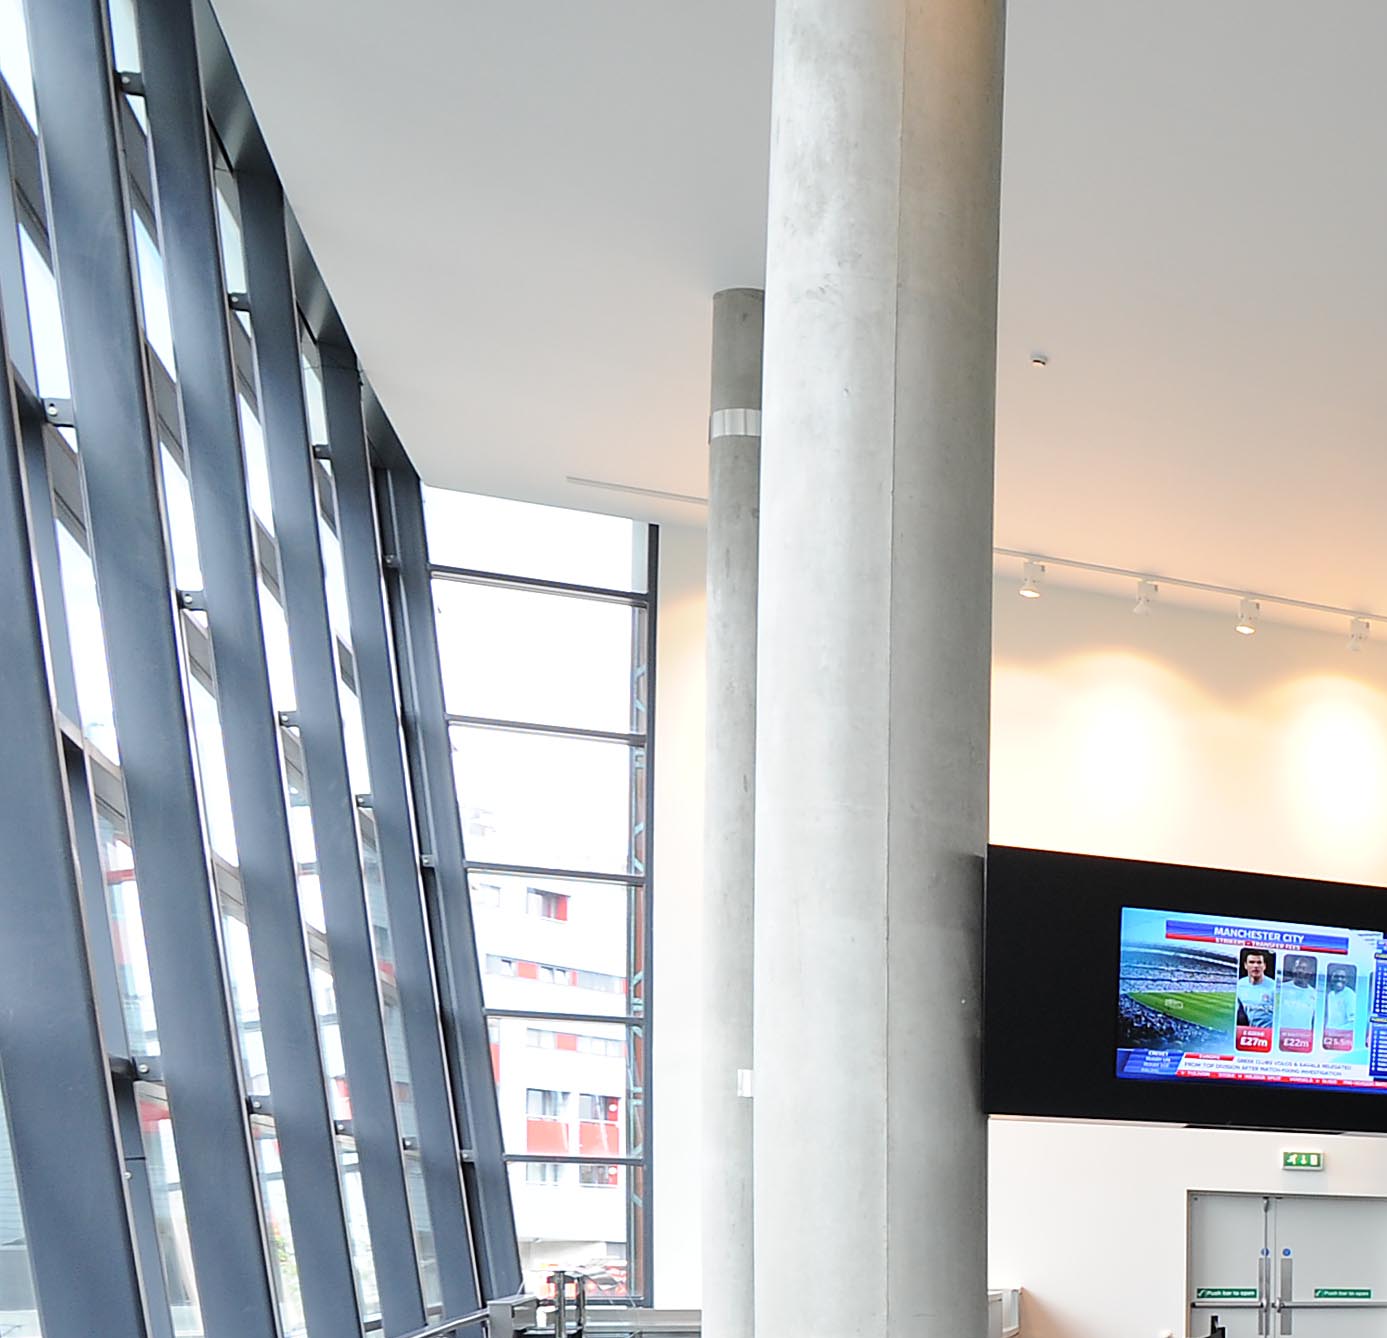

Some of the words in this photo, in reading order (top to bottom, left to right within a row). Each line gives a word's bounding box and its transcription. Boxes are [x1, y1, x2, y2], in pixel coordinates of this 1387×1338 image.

[1214, 927, 1281, 941] MANCHESTER
[1282, 934, 1305, 943] CITY
[1240, 1037, 1268, 1047] £27m
[1283, 1038, 1310, 1048] £22m
